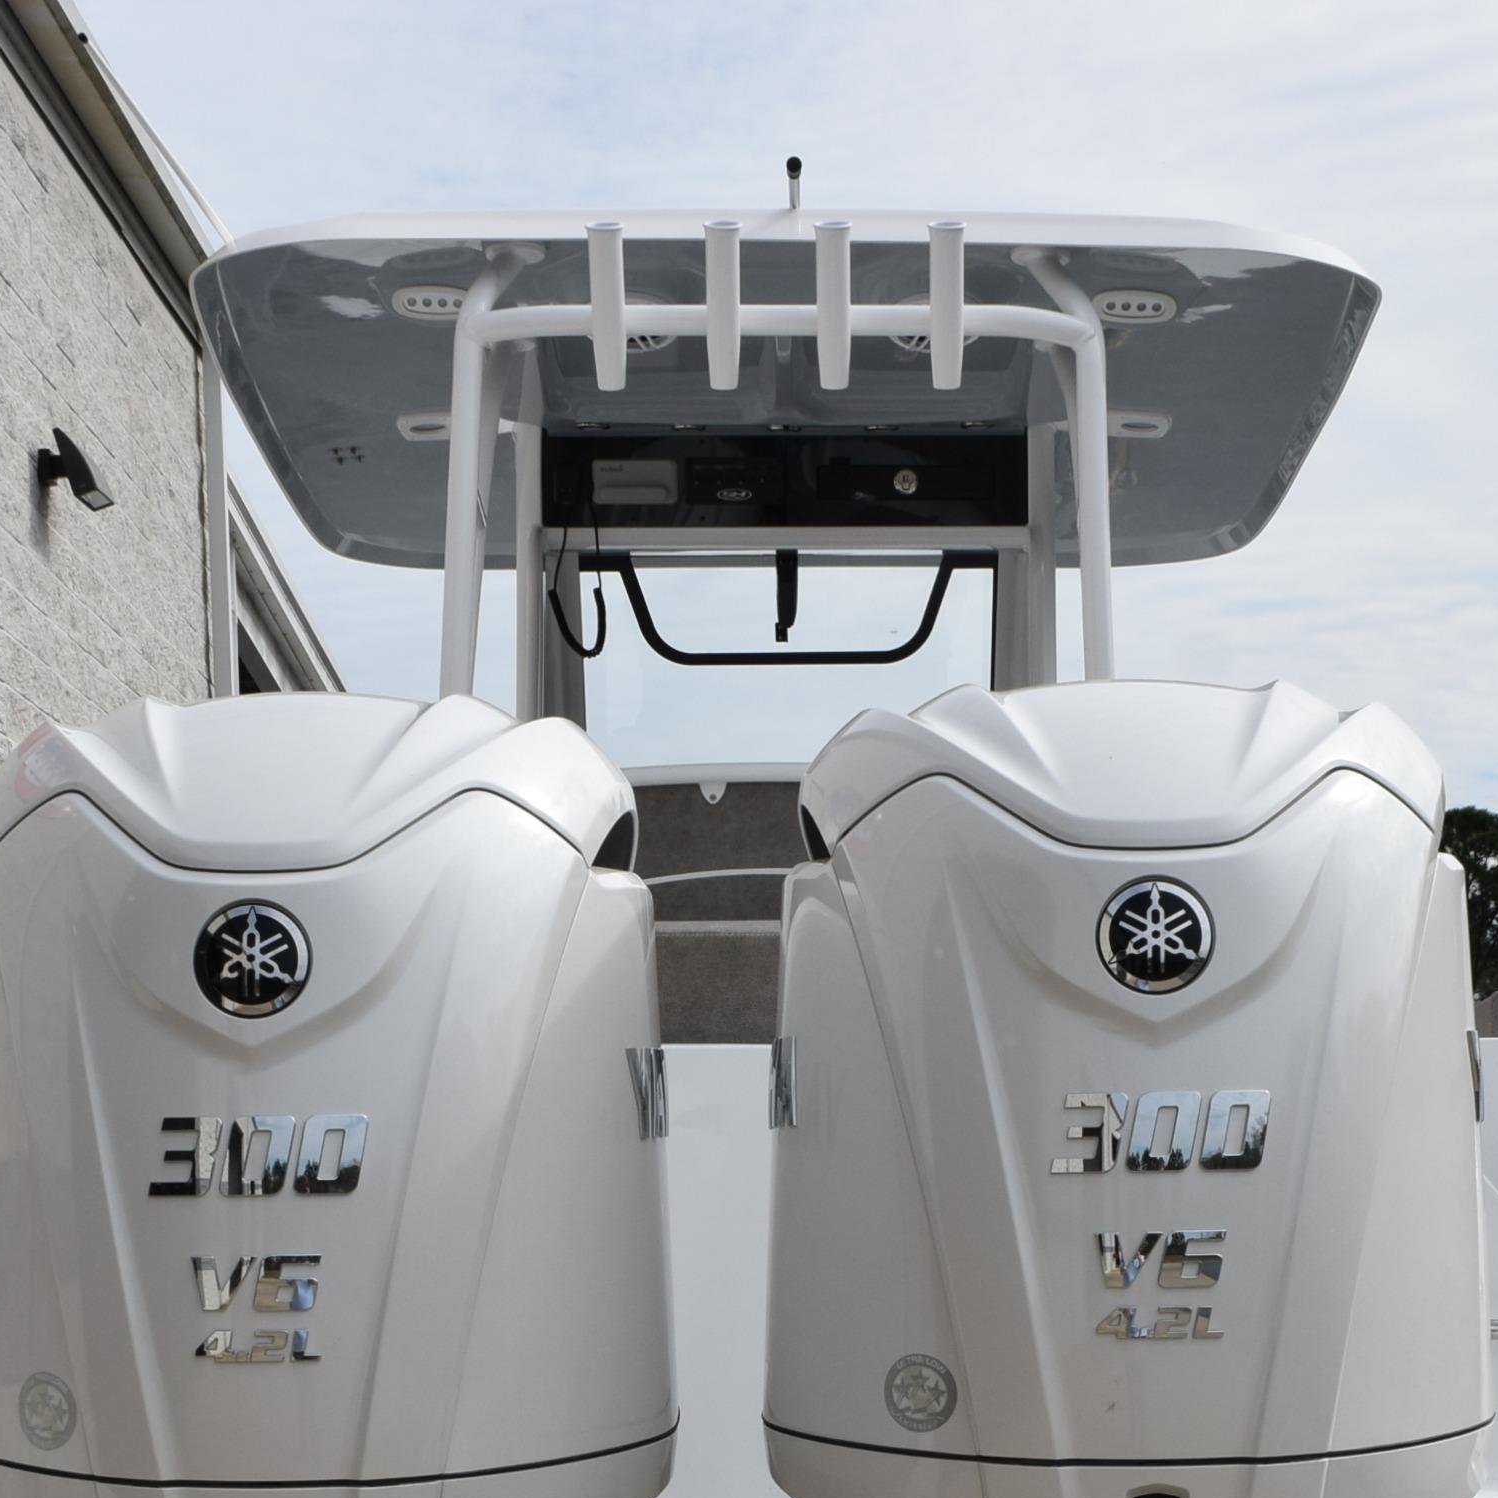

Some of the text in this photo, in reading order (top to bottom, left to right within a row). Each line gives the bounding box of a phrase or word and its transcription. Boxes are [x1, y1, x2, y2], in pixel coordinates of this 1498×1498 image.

[148, 1114, 369, 1197] 300
[1050, 1089, 1271, 1174] 300
[190, 1253, 323, 1313] V6
[1095, 1228, 1228, 1289] V6
[194, 1328, 324, 1364] 4.2L
[1095, 1305, 1227, 1340] 4.2L
